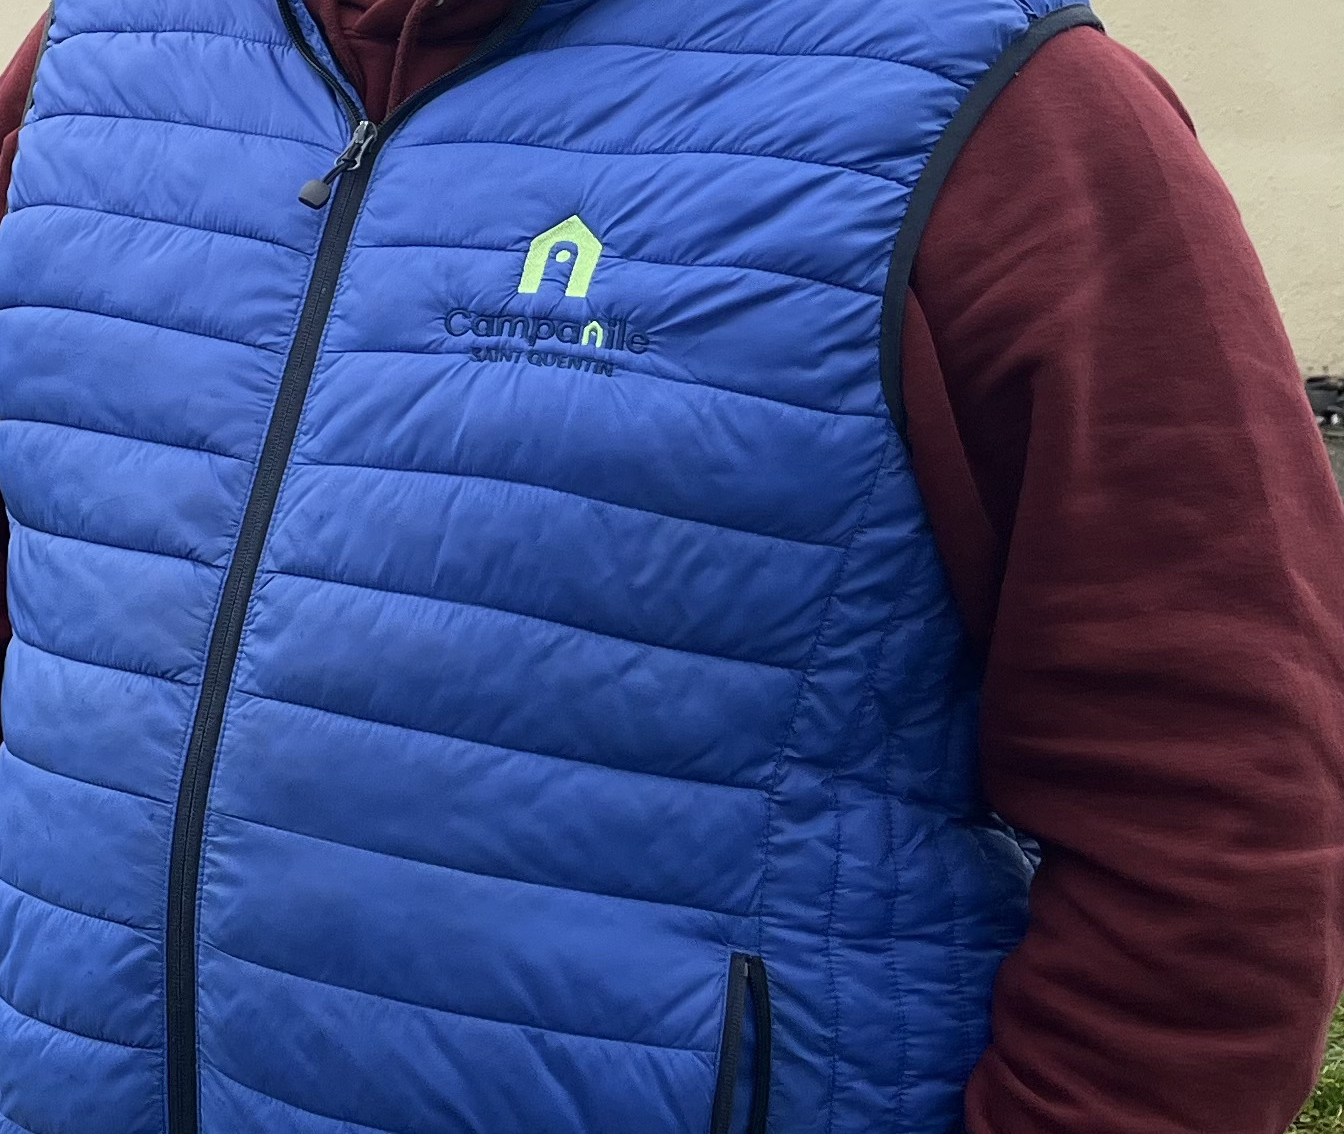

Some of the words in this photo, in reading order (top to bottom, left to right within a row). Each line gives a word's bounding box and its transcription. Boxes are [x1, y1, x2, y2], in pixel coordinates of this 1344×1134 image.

[444, 307, 650, 355] Campanile
[469, 346, 520, 364] SAINT
[526, 350, 614, 377] QUENTIN
